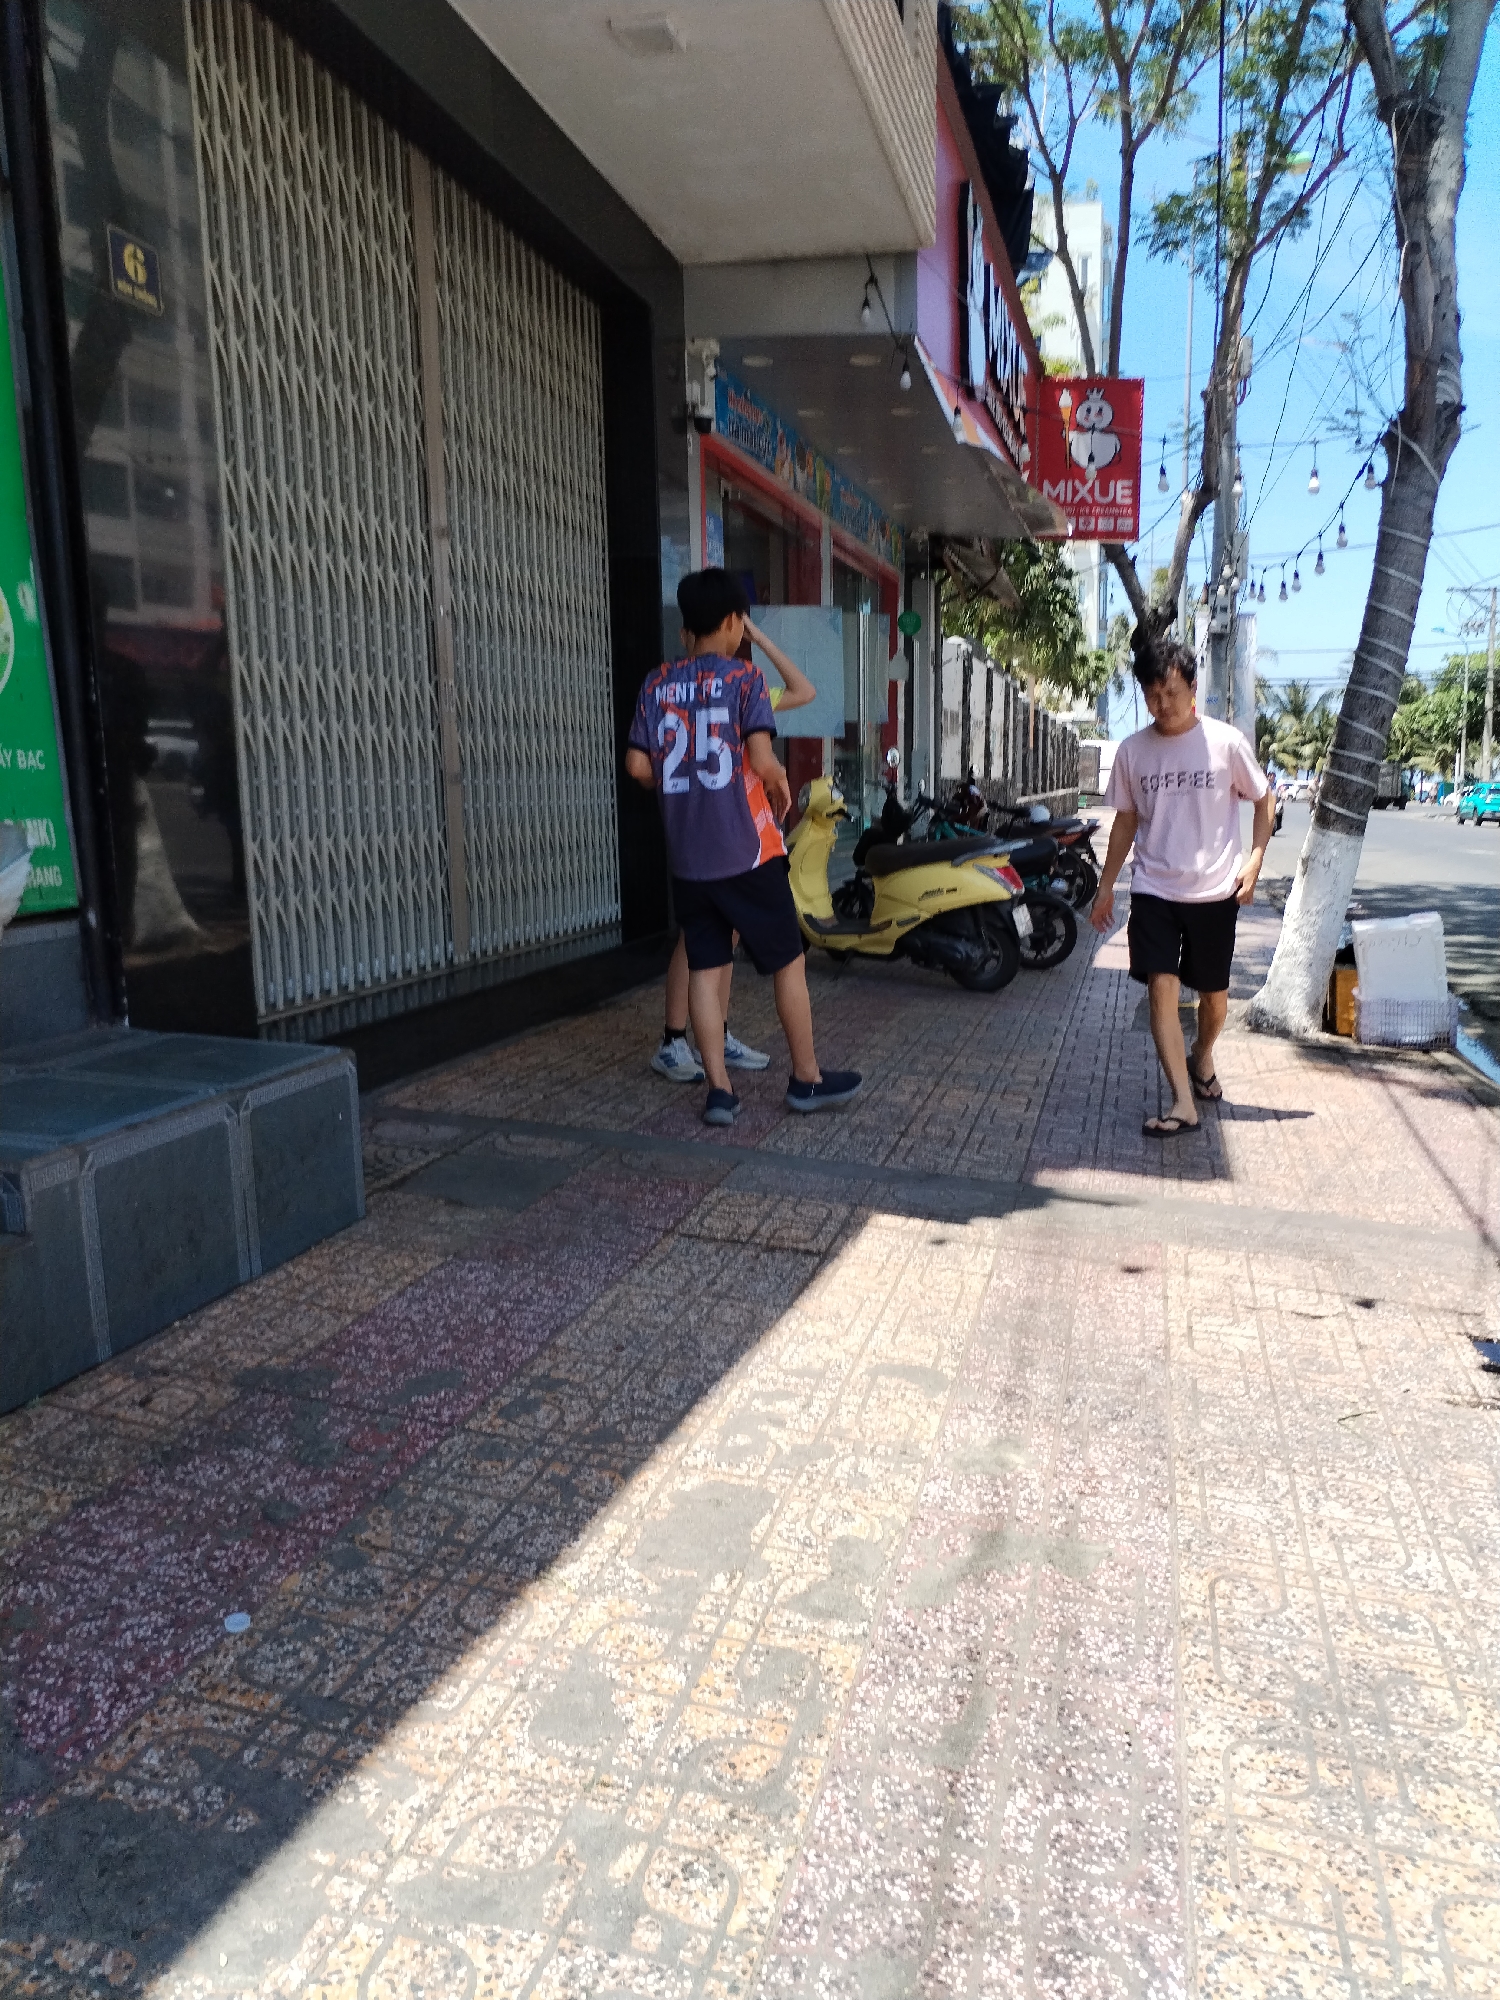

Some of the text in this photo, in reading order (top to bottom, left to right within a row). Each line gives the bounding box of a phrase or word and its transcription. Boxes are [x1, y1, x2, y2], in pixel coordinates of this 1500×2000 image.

[123, 243, 148, 285] 6
[1042, 479, 1133, 505] MIXUE
[655, 678, 723, 706] MENT FC
[657, 706, 733, 795] 25
